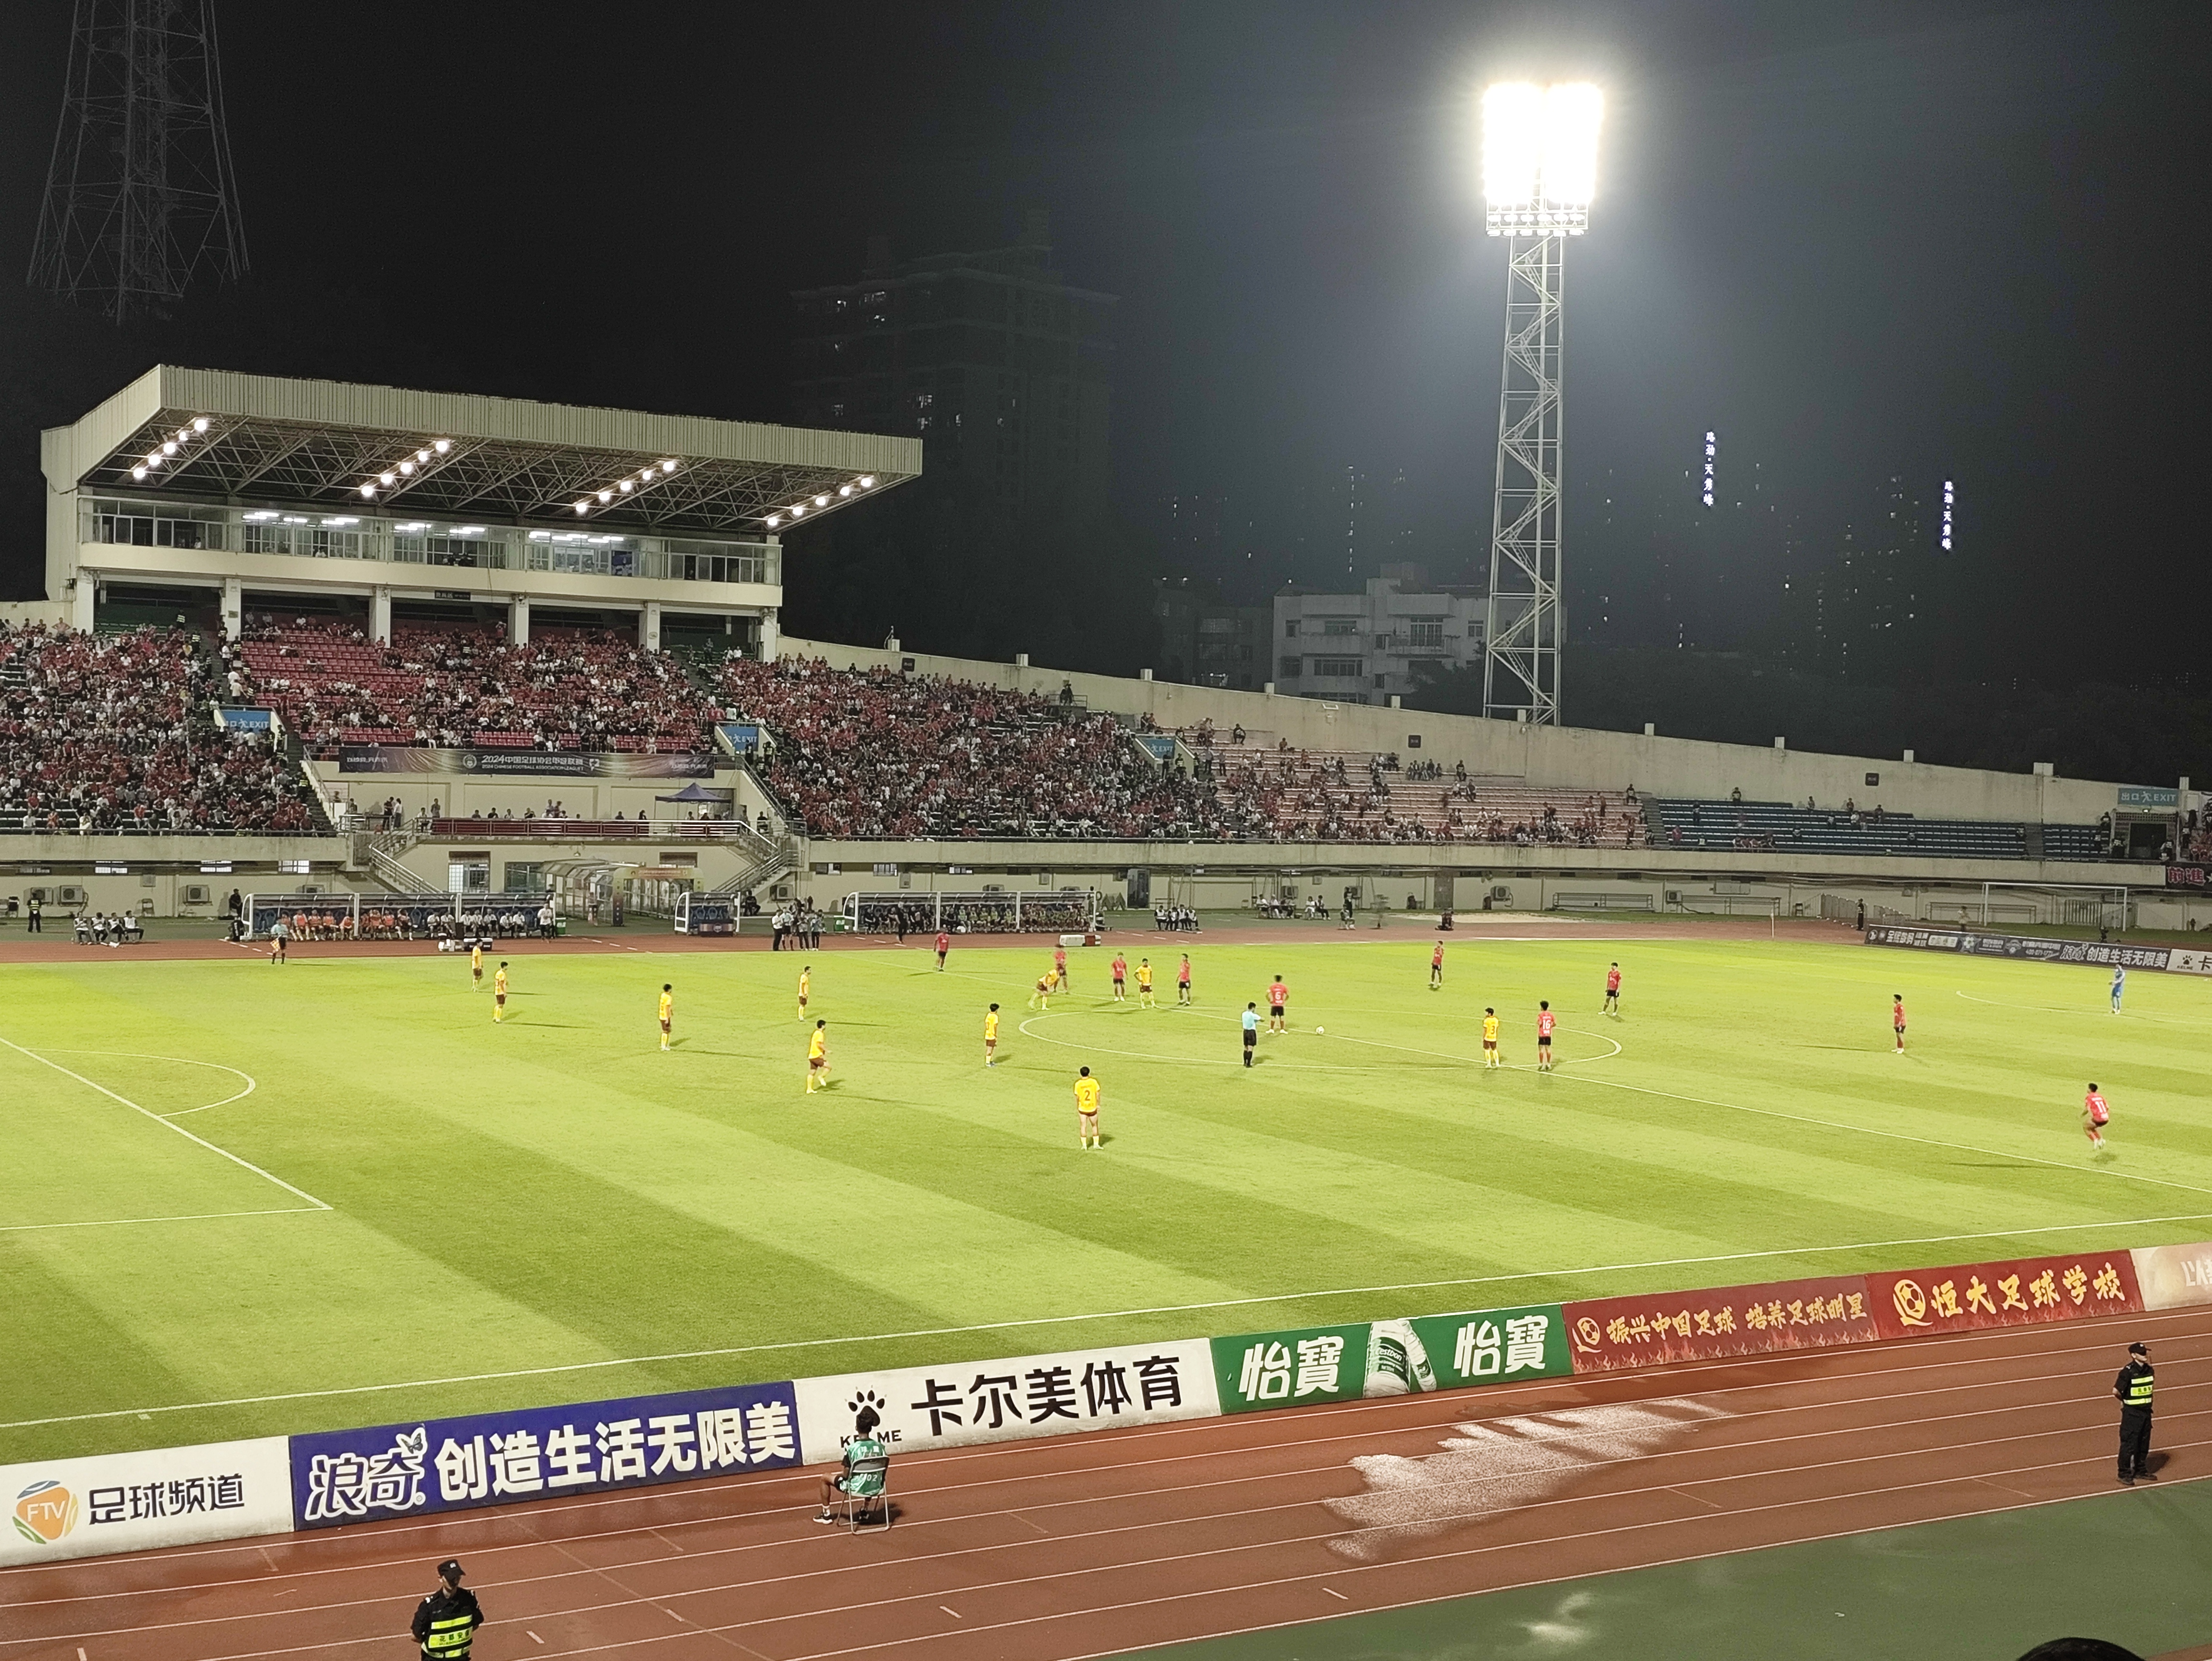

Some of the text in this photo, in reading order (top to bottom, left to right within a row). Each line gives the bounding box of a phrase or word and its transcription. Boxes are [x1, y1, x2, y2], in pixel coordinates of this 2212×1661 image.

[2121, 792, 2176, 802] 出口 EXIT
[2167, 866, 2207, 886] 前進
[2086, 946, 2168, 968] 创造生活无限美
[1275, 991, 1281, 1000] 6
[1543, 1019, 1551, 1030] 16
[1084, 1090, 1090, 1101] 2
[2095, 1101, 2106, 1113] 11
[1931, 1262, 2125, 1318] 恒大足球学校
[1606, 1292, 1867, 1345] 振兴中国足球 培养足球明星
[911, 1355, 1182, 1436] 卡尔美体育
[305, 1401, 796, 1520] 浪奇 创造生活无限美
[89, 1473, 245, 1525] 足球频道
[26, 1500, 66, 1522] FTV
